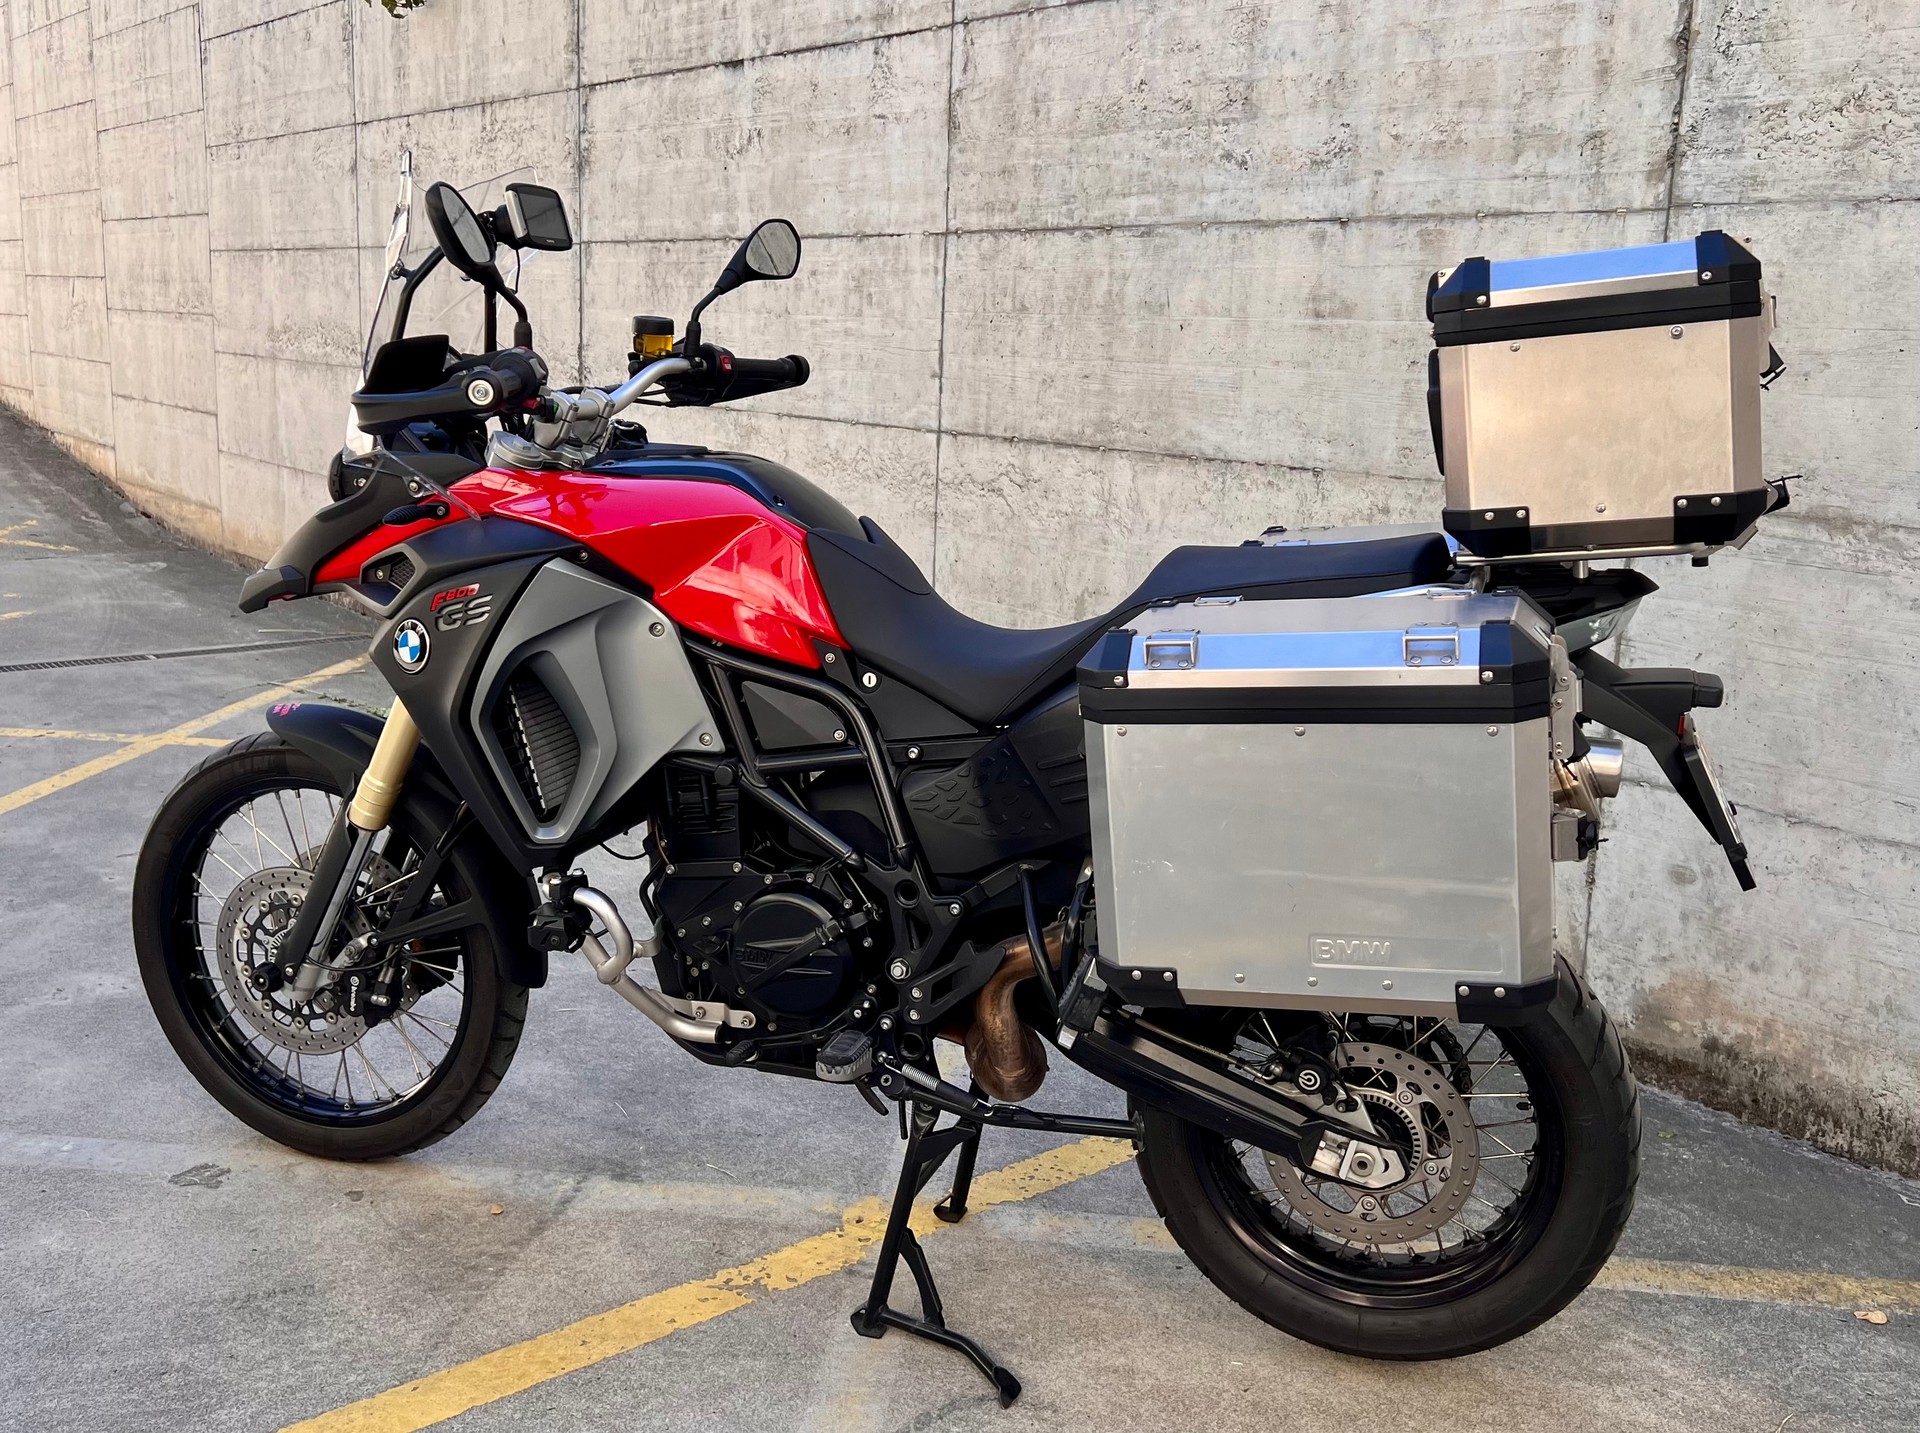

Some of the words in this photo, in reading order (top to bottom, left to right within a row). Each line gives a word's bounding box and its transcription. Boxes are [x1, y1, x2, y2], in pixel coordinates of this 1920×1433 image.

[430, 583, 480, 611] F800
[435, 594, 493, 632] GS
[1315, 939, 1391, 962] BMW
